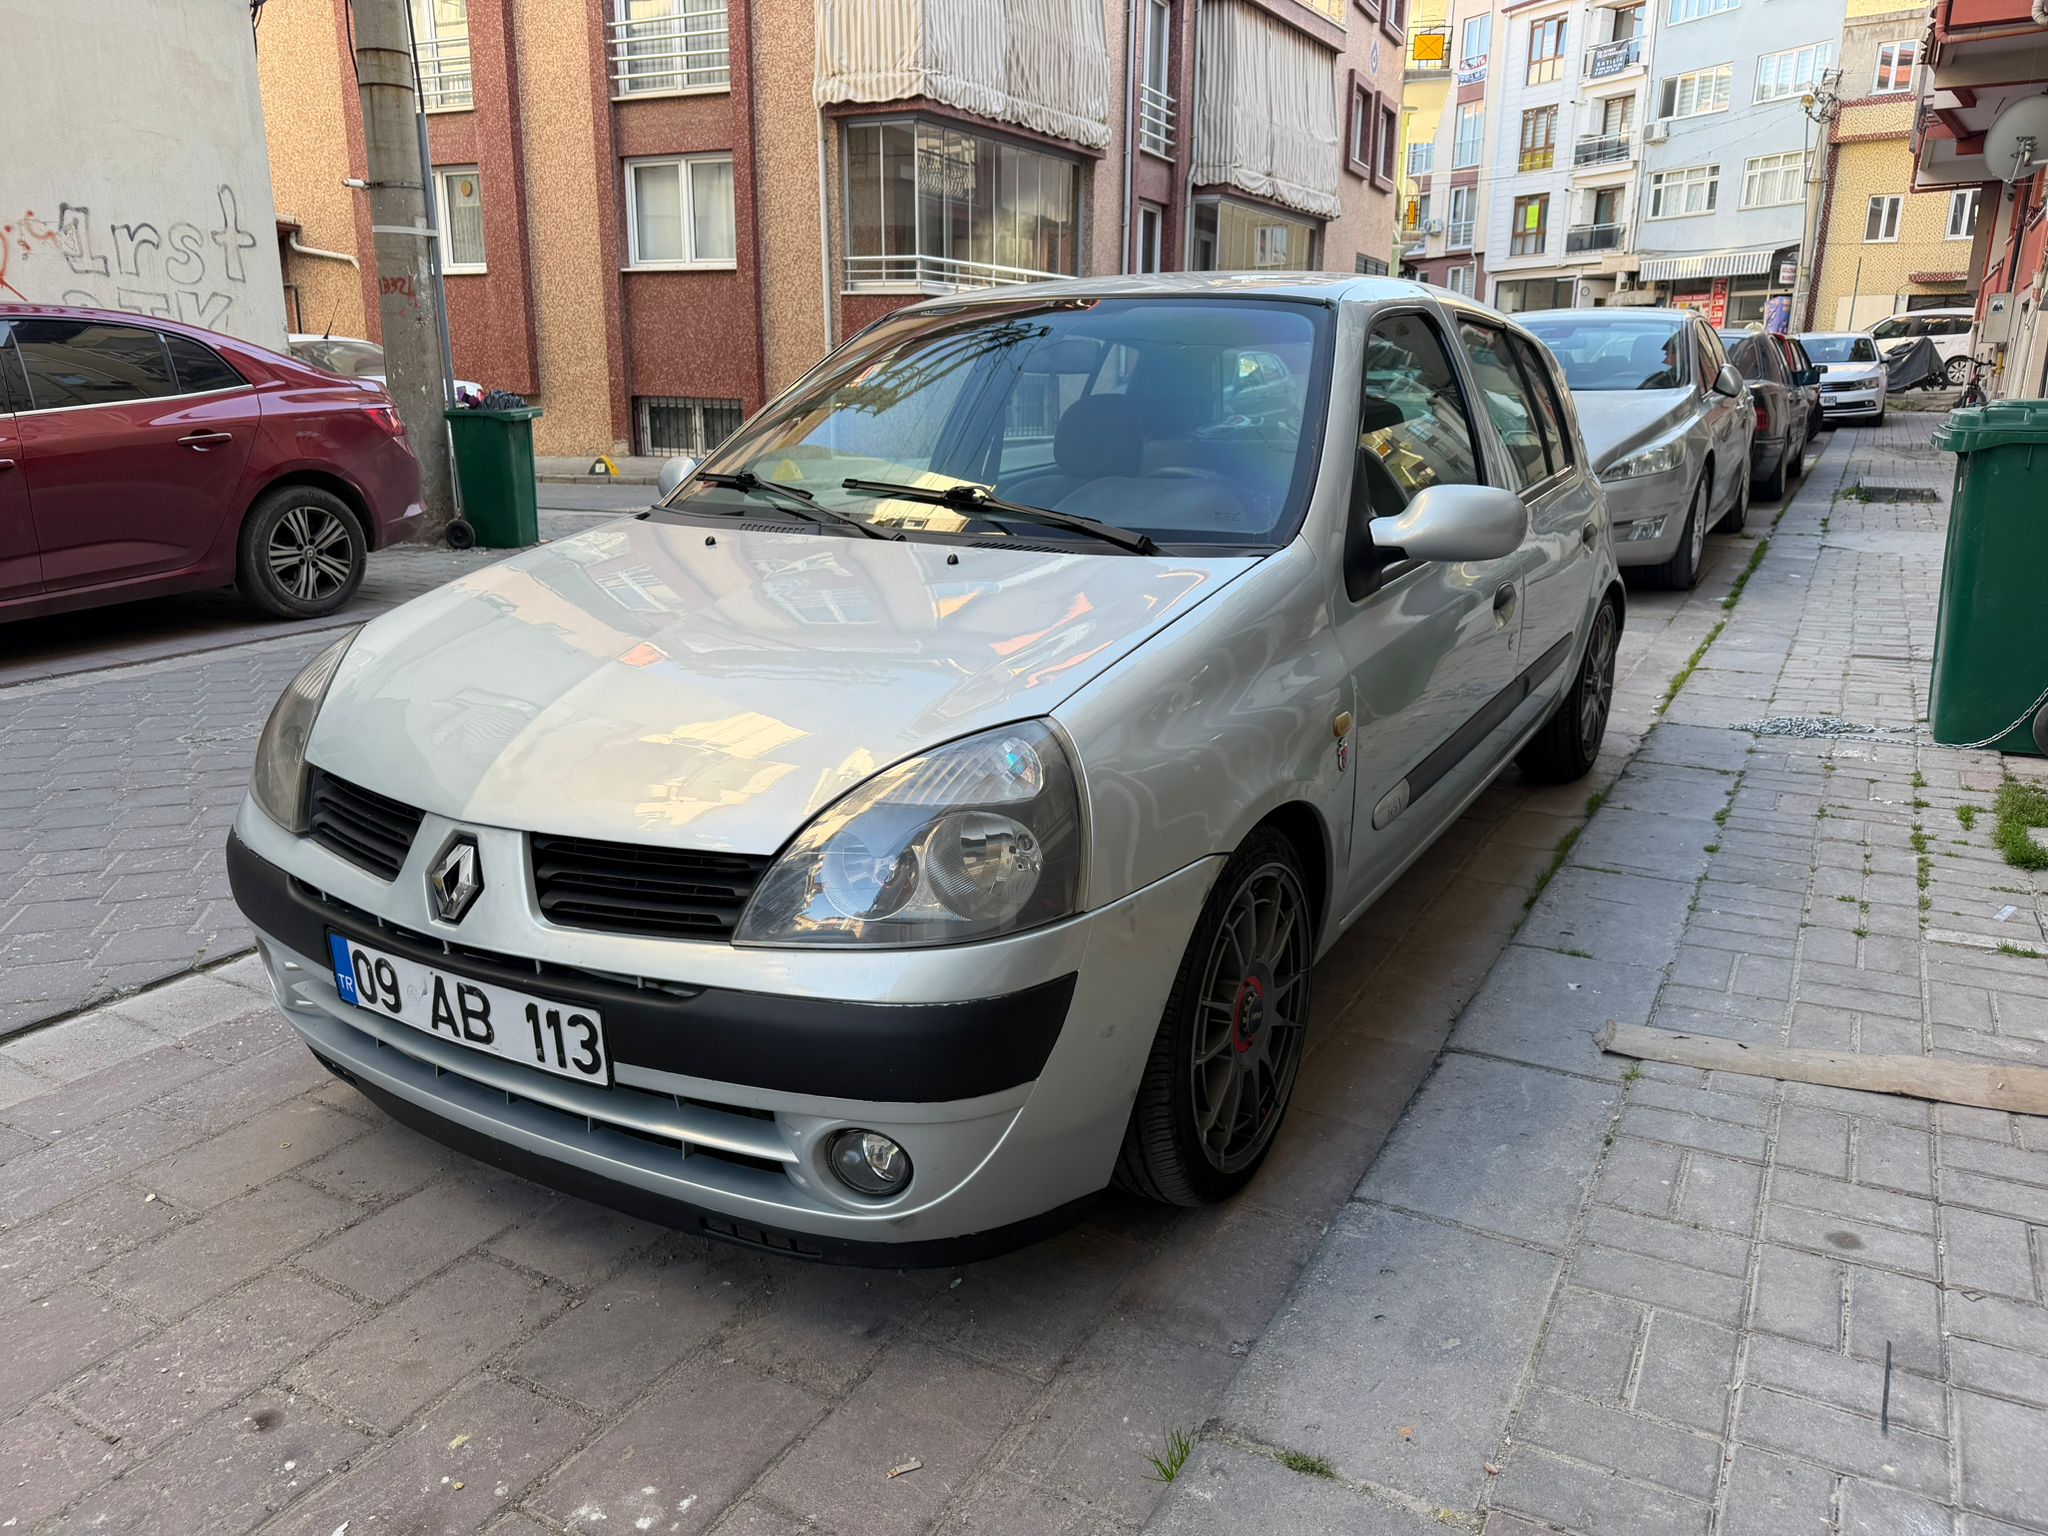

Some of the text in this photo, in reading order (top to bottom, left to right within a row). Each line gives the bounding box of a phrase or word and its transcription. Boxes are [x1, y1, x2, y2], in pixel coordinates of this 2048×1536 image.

[337, 973, 355, 993] TR
[351, 949, 602, 1075] 09 AB 113
